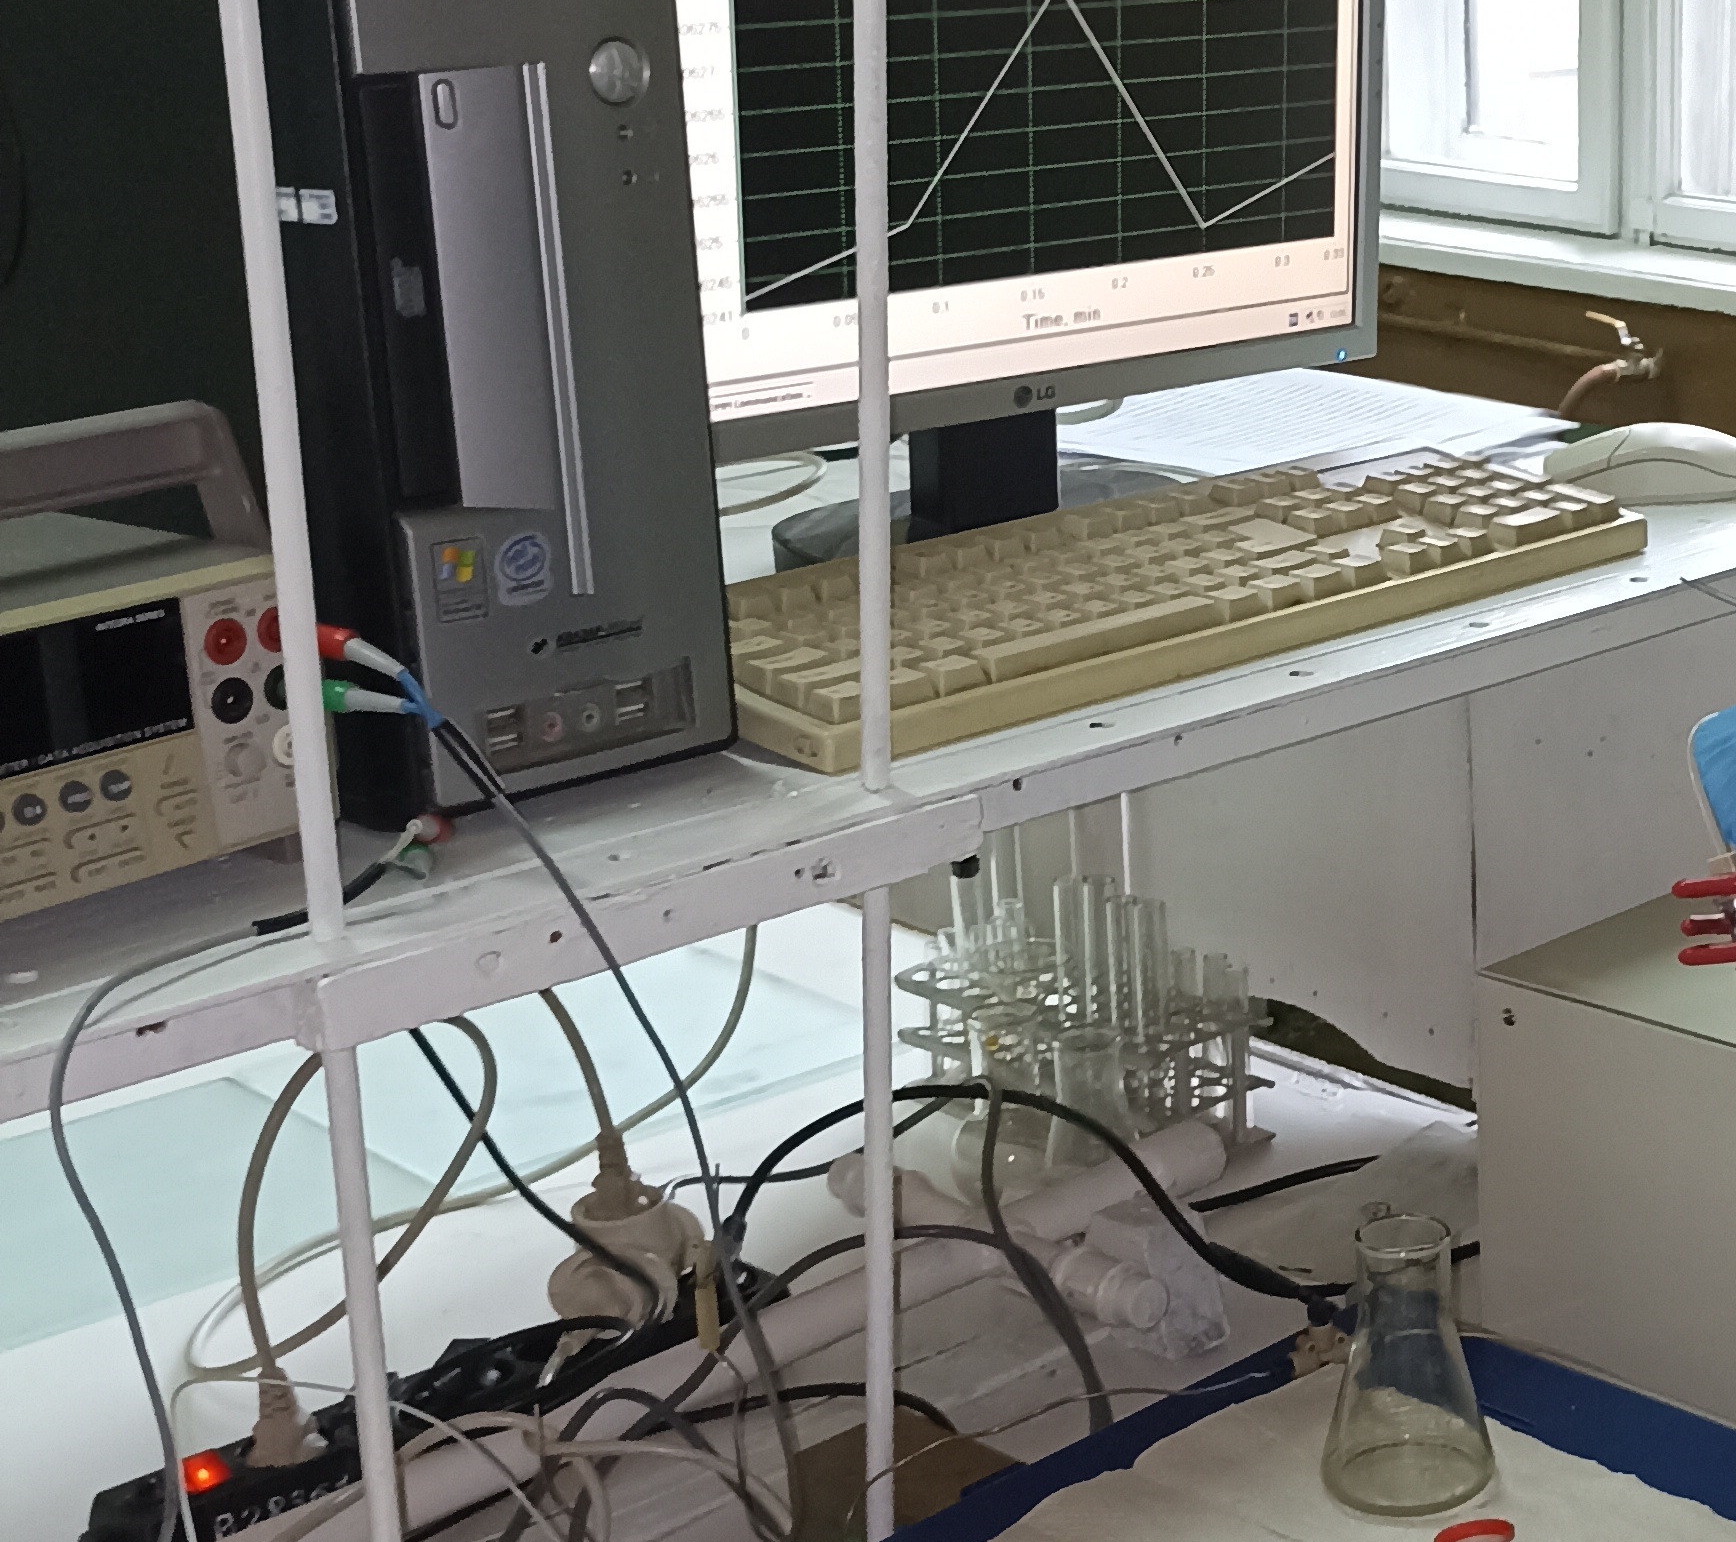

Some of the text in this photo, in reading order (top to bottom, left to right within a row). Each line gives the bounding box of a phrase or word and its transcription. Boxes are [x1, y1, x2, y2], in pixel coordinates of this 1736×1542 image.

[1021, 307, 1101, 332] Time, min
[1036, 385, 1056, 400] LG
